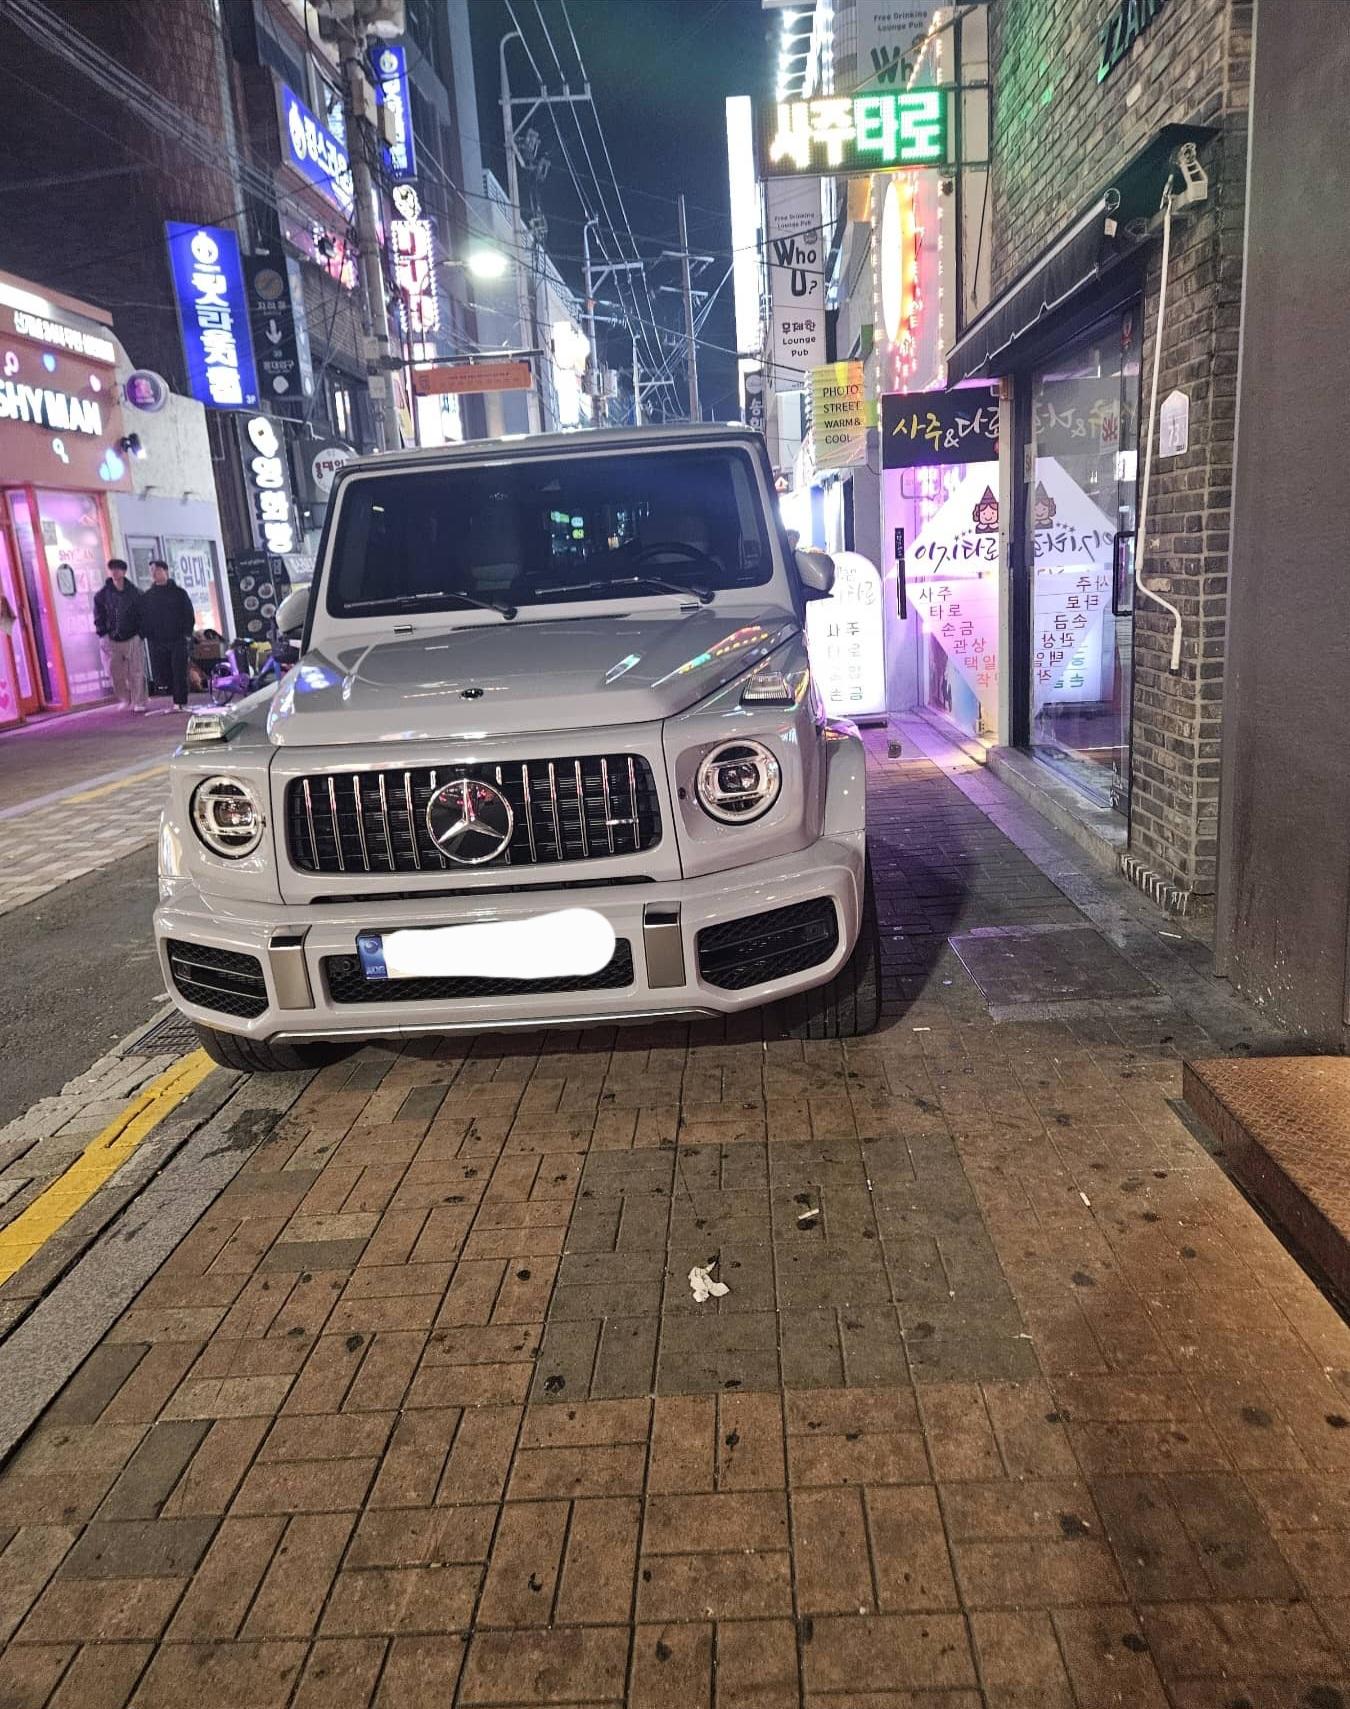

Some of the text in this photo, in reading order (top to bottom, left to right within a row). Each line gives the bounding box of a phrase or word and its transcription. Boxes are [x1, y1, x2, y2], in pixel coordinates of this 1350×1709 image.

[873, 11, 928, 22] Free Drinking
[878, 23, 906, 32] Lounge
[871, 46, 914, 84] Wh
[789, 212, 815, 220] Drinking
[772, 239, 817, 266] Who
[782, 319, 816, 334] 무제한
[782, 336, 816, 345] Lounge
[823, 385, 859, 398] PHOTO
[823, 401, 862, 414] STREET
[825, 435, 852, 444] COOL
[180, 554, 207, 588] 임대
[919, 586, 953, 603] 사주
[929, 604, 963, 620] 타로
[941, 621, 974, 638] 손금
[953, 637, 987, 655] 관상
[964, 655, 996, 671] 택일
[977, 673, 999, 688] 작
